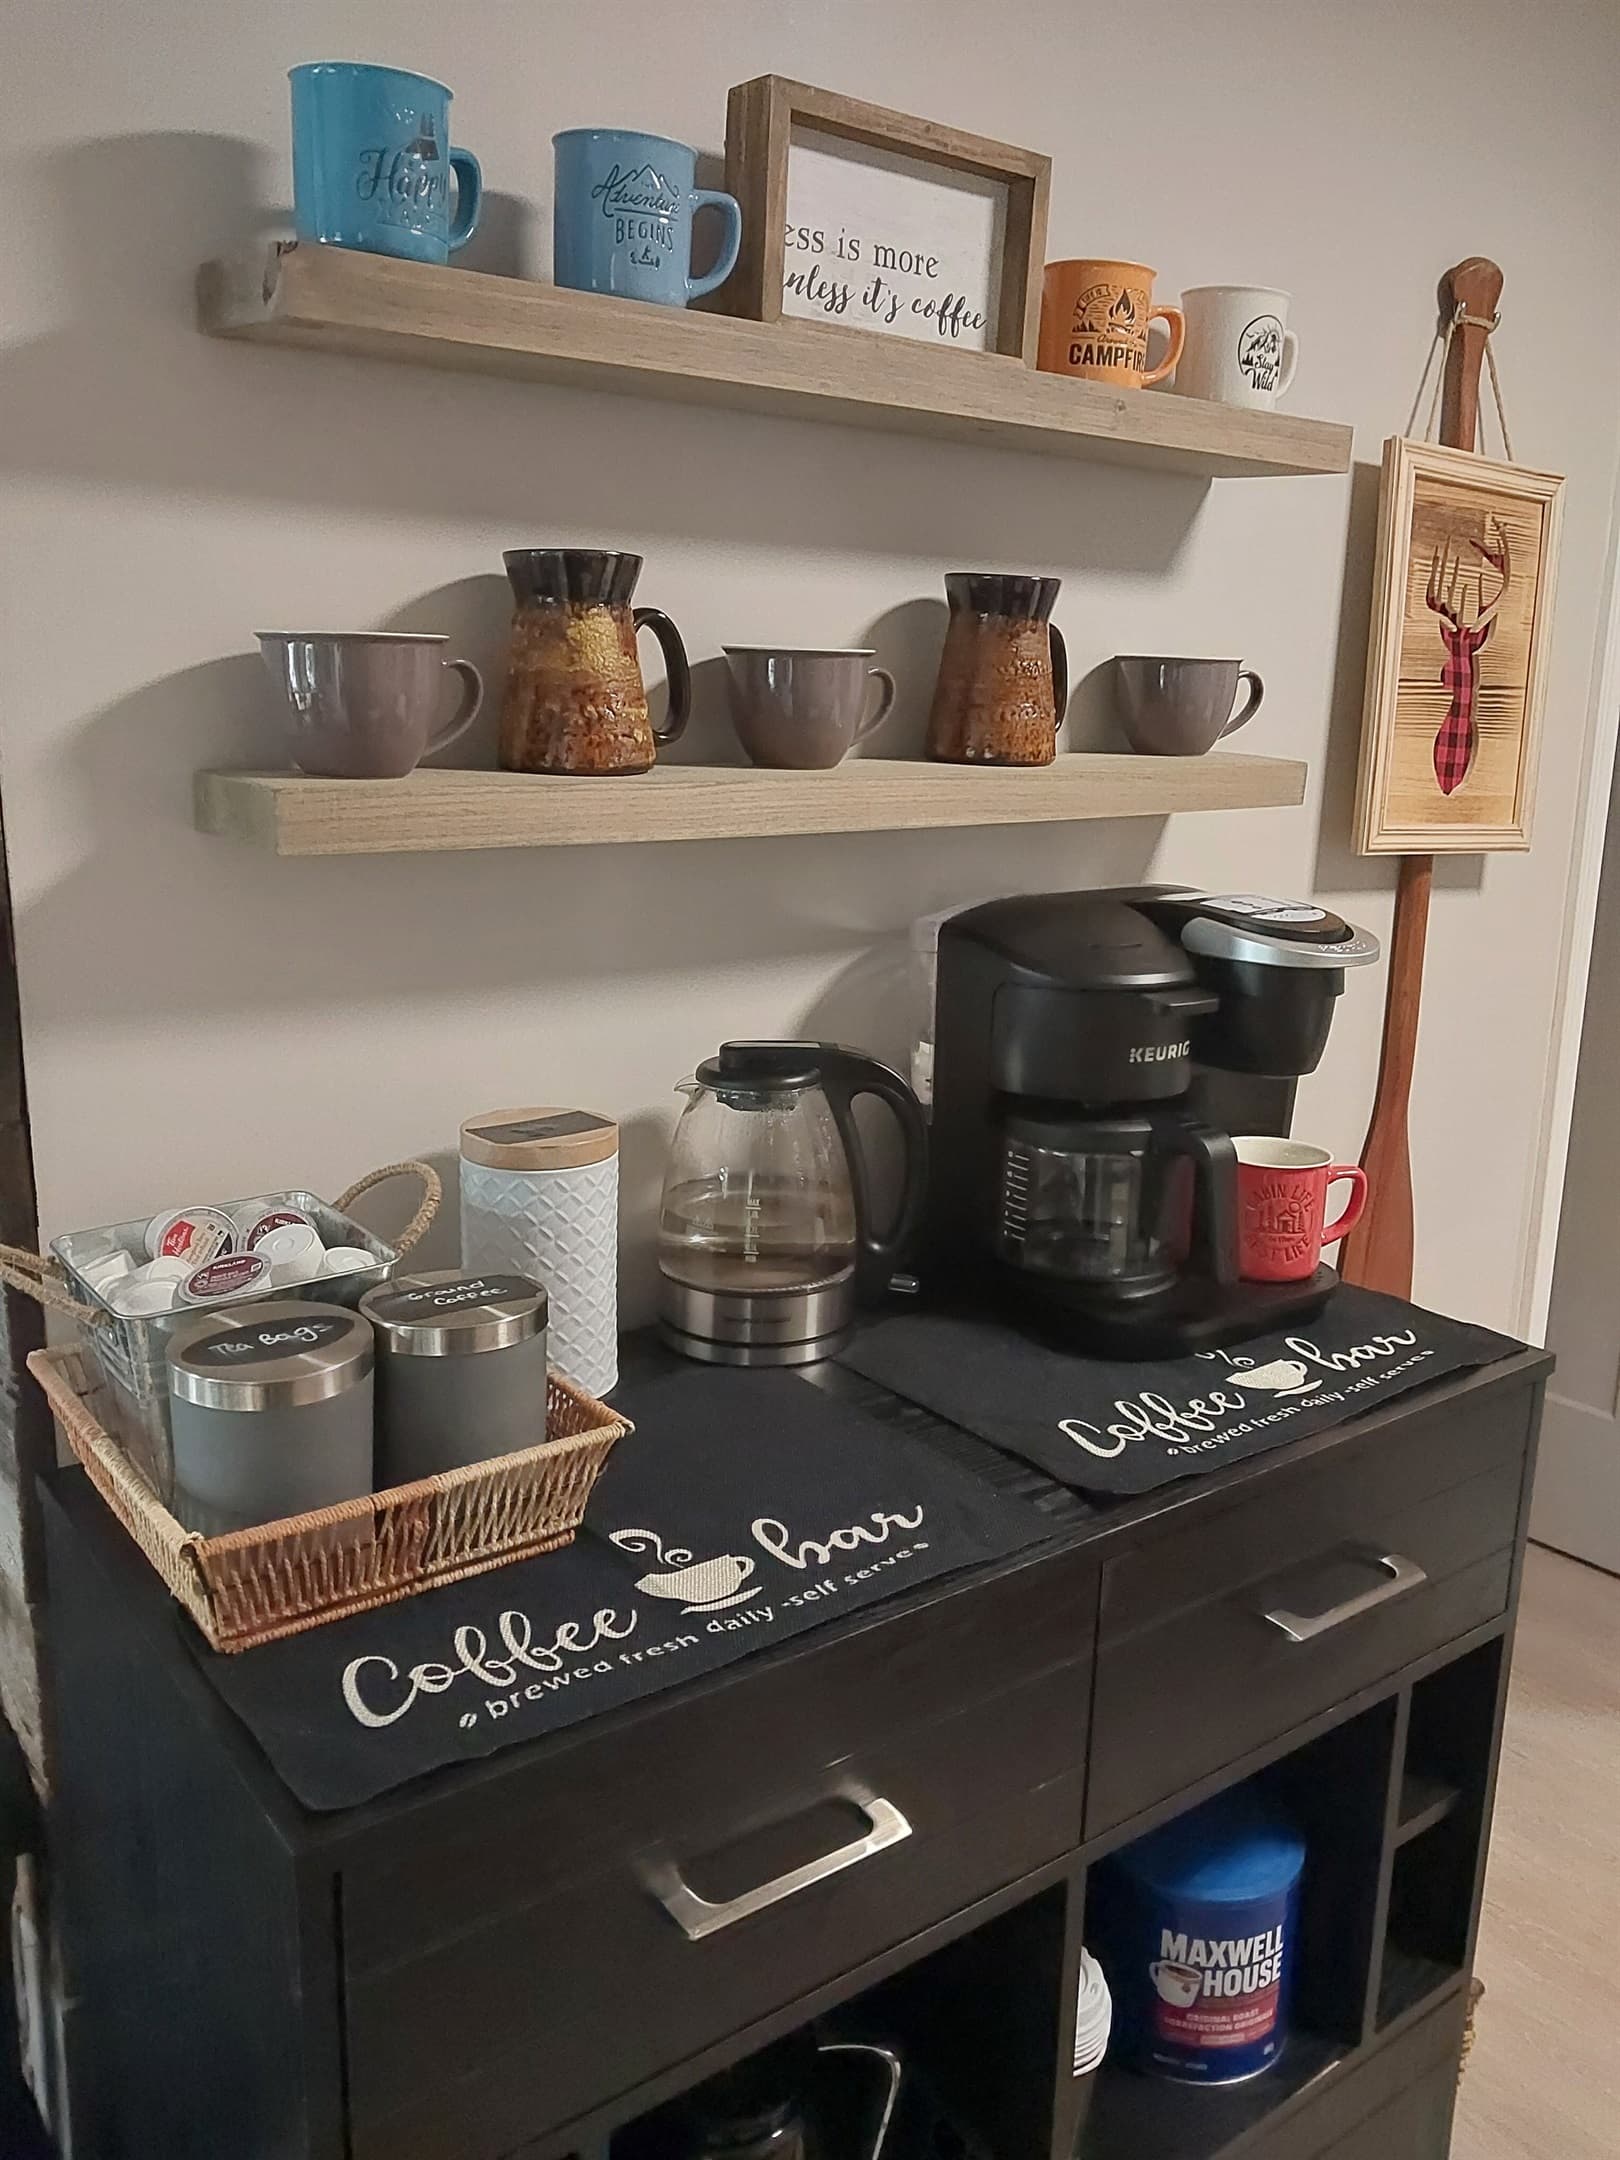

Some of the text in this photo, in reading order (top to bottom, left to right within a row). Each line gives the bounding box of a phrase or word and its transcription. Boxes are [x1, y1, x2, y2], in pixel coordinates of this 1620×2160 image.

[615, 218, 674, 252] BEGINS
[783, 223, 940, 279] ess is more
[783, 264, 988, 338] nless it's coffee
[1068, 343, 1145, 374] CAMPFIR
[1244, 367, 1278, 391] Wild
[1255, 353, 1275, 373] Stay
[1128, 1039, 1190, 1063] KEURIG
[207, 1342, 255, 1356] Tea
[1057, 1328, 1417, 1459] Coffee bar
[1177, 1422, 1254, 1456] brewed
[1250, 1405, 1301, 1428] fresh
[1300, 1391, 1346, 1408] daily
[341, 1504, 925, 1728] Coffee bar
[484, 1659, 614, 1720] brewed
[618, 1634, 700, 1666] fresh
[705, 1605, 775, 1634] daily
[1160, 1924, 1283, 1968] MAXWELL
[1203, 1952, 1282, 1997] HOUSE
